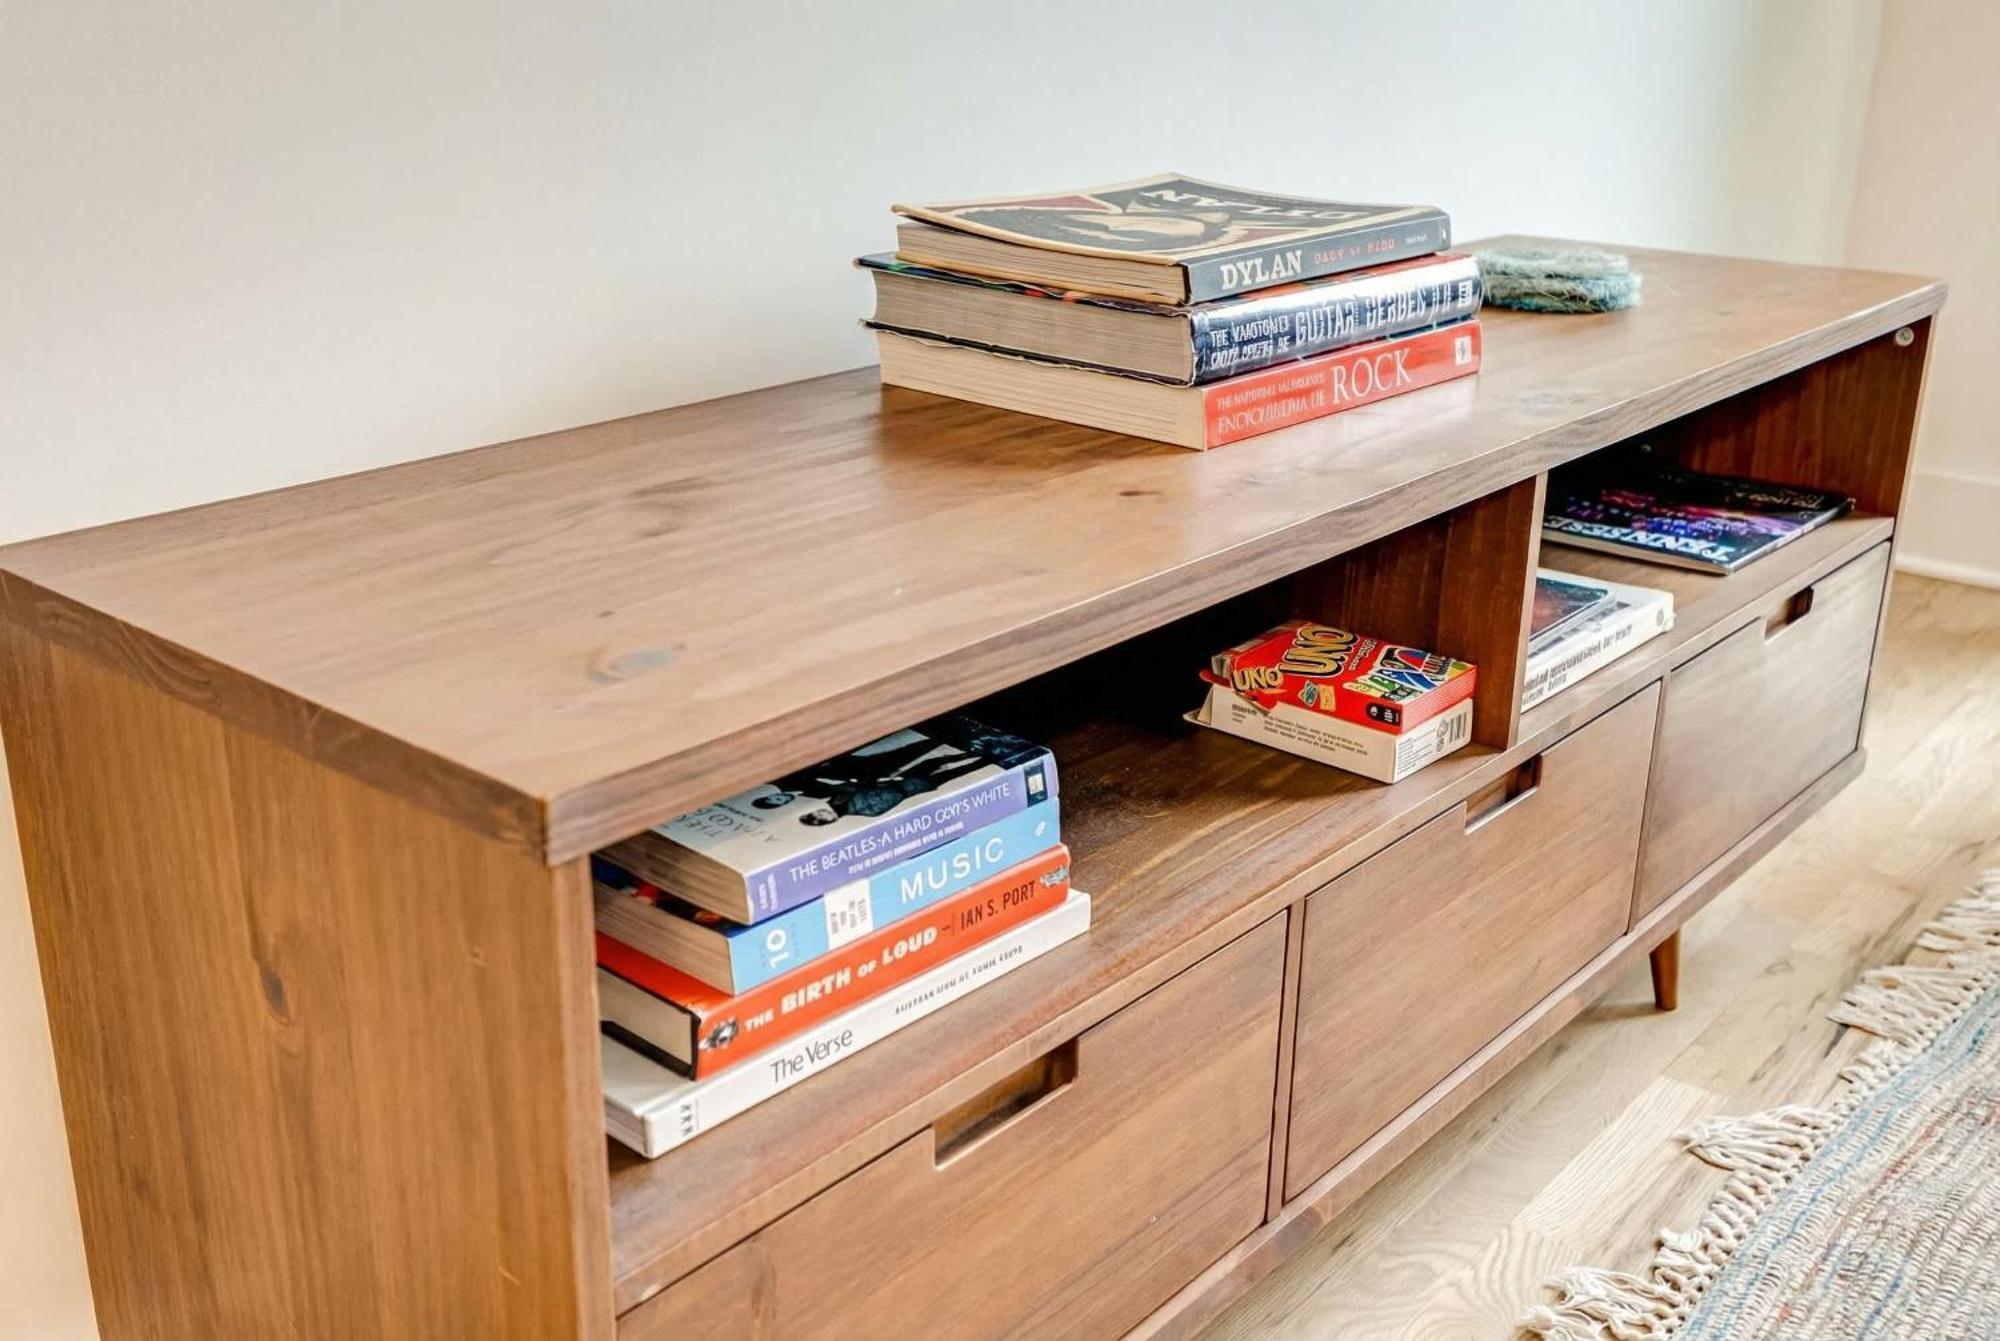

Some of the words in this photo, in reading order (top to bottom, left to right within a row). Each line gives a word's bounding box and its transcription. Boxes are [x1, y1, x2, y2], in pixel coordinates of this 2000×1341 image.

[1220, 251, 1302, 290] DYLAN
[1332, 348, 1414, 405] ROCK
[1279, 625, 1359, 677] UNO
[1232, 667, 1284, 692] UNO
[789, 861, 818, 883] THE
[895, 814, 932, 839] HARD
[901, 837, 1004, 902] MUSIC
[960, 905, 983, 930] IAN
[985, 899, 998, 917] S.
[1003, 880, 1036, 910] PORT
[745, 1011, 773, 1033] THE
[781, 967, 850, 1016] BIRTH
[857, 959, 877, 979] OF
[882, 927, 938, 965] LOUD
[770, 1050, 804, 1084] The
[805, 1028, 853, 1071] Verse
